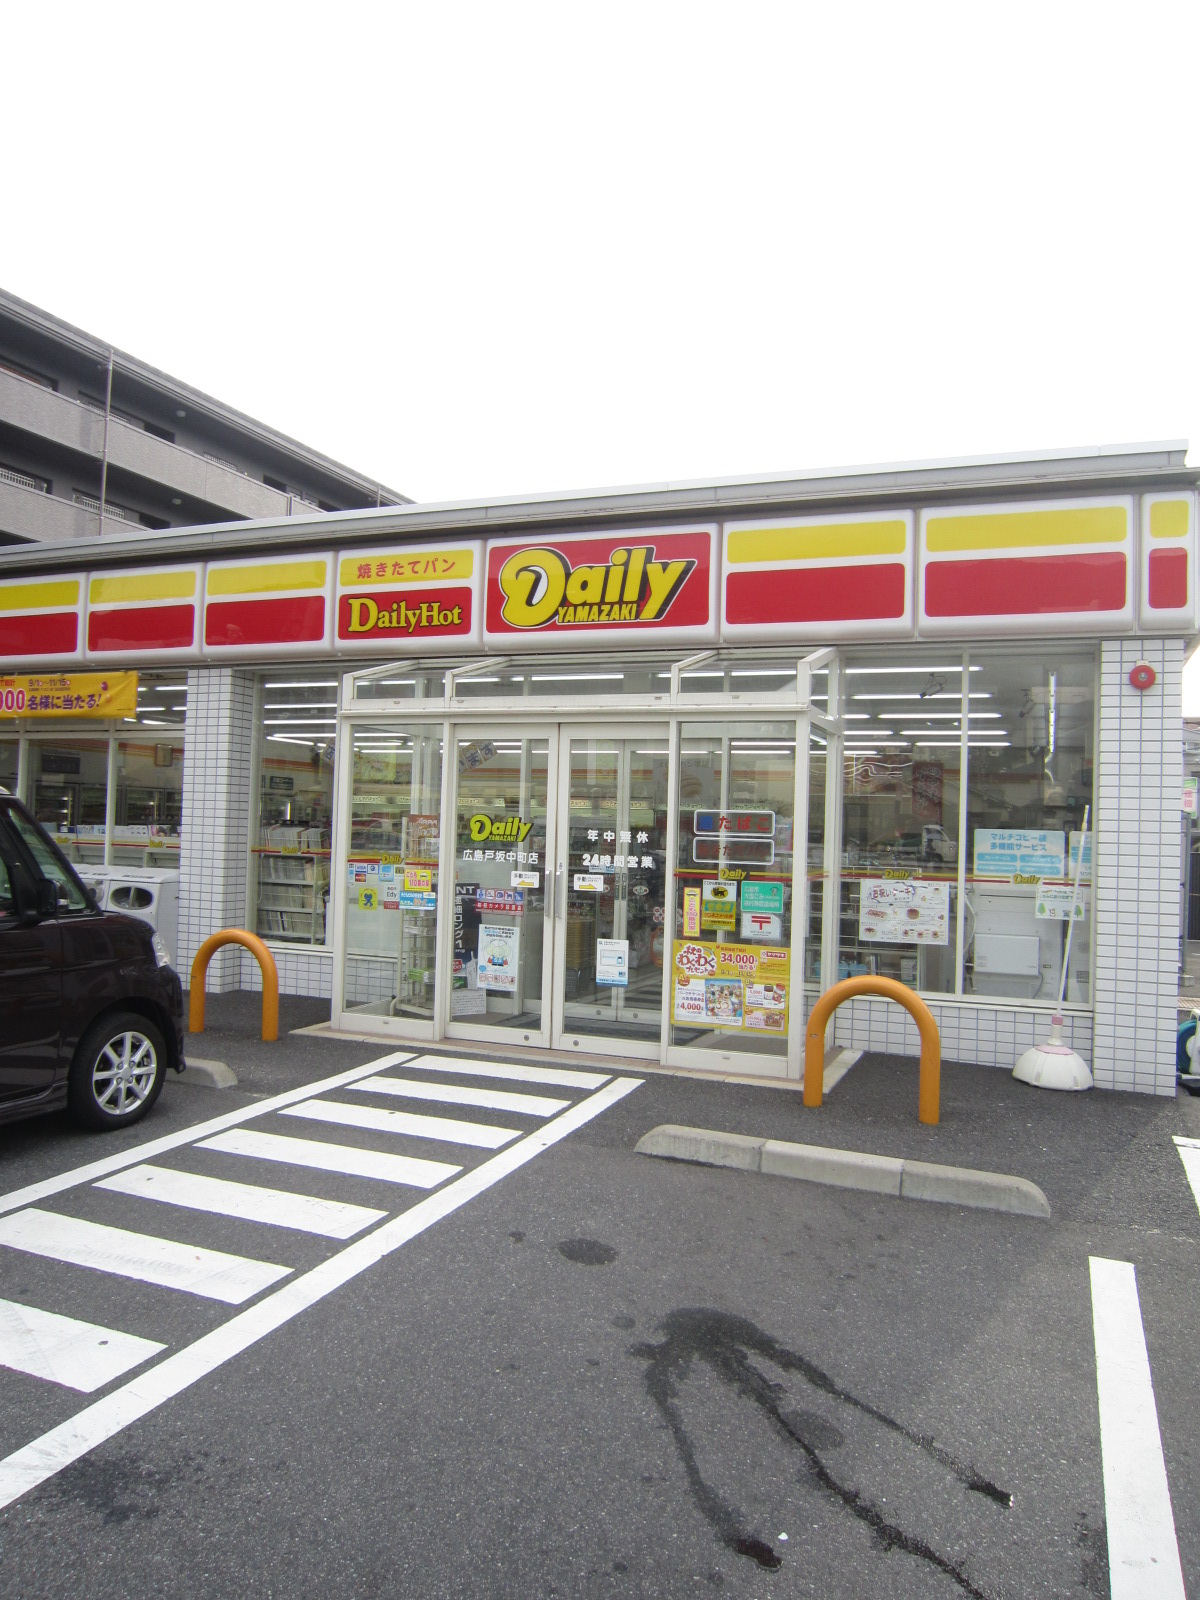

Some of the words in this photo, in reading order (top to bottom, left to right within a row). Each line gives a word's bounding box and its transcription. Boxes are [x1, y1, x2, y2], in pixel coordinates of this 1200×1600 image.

[357, 558, 456, 580] 焼きたてパン
[501, 547, 695, 627] Daily
[347, 597, 464, 633] DailyHot
[557, 605, 637, 624] YAMAZAKI
[469, 814, 534, 842] Daily
[587, 829, 649, 843] 年中無休
[990, 833, 1047, 842] マルチコピー機
[990, 842, 1047, 851] 多機能サービス
[381, 853, 404, 864] Daily
[462, 849, 539, 865] 広島戸坂中町店
[582, 853, 653, 868] 24時間営業
[719, 868, 748, 880] Daily
[883, 868, 912, 879] Daily
[386, 891, 398, 899] Edy
[872, 887, 911, 899] お祝いケーキ
[683, 945, 702, 956] 秋の
[677, 953, 716, 969] わくわく
[720, 952, 755, 965] 34,000
[686, 966, 709, 974] プレゼント
[680, 1002, 701, 1011] 4,000
